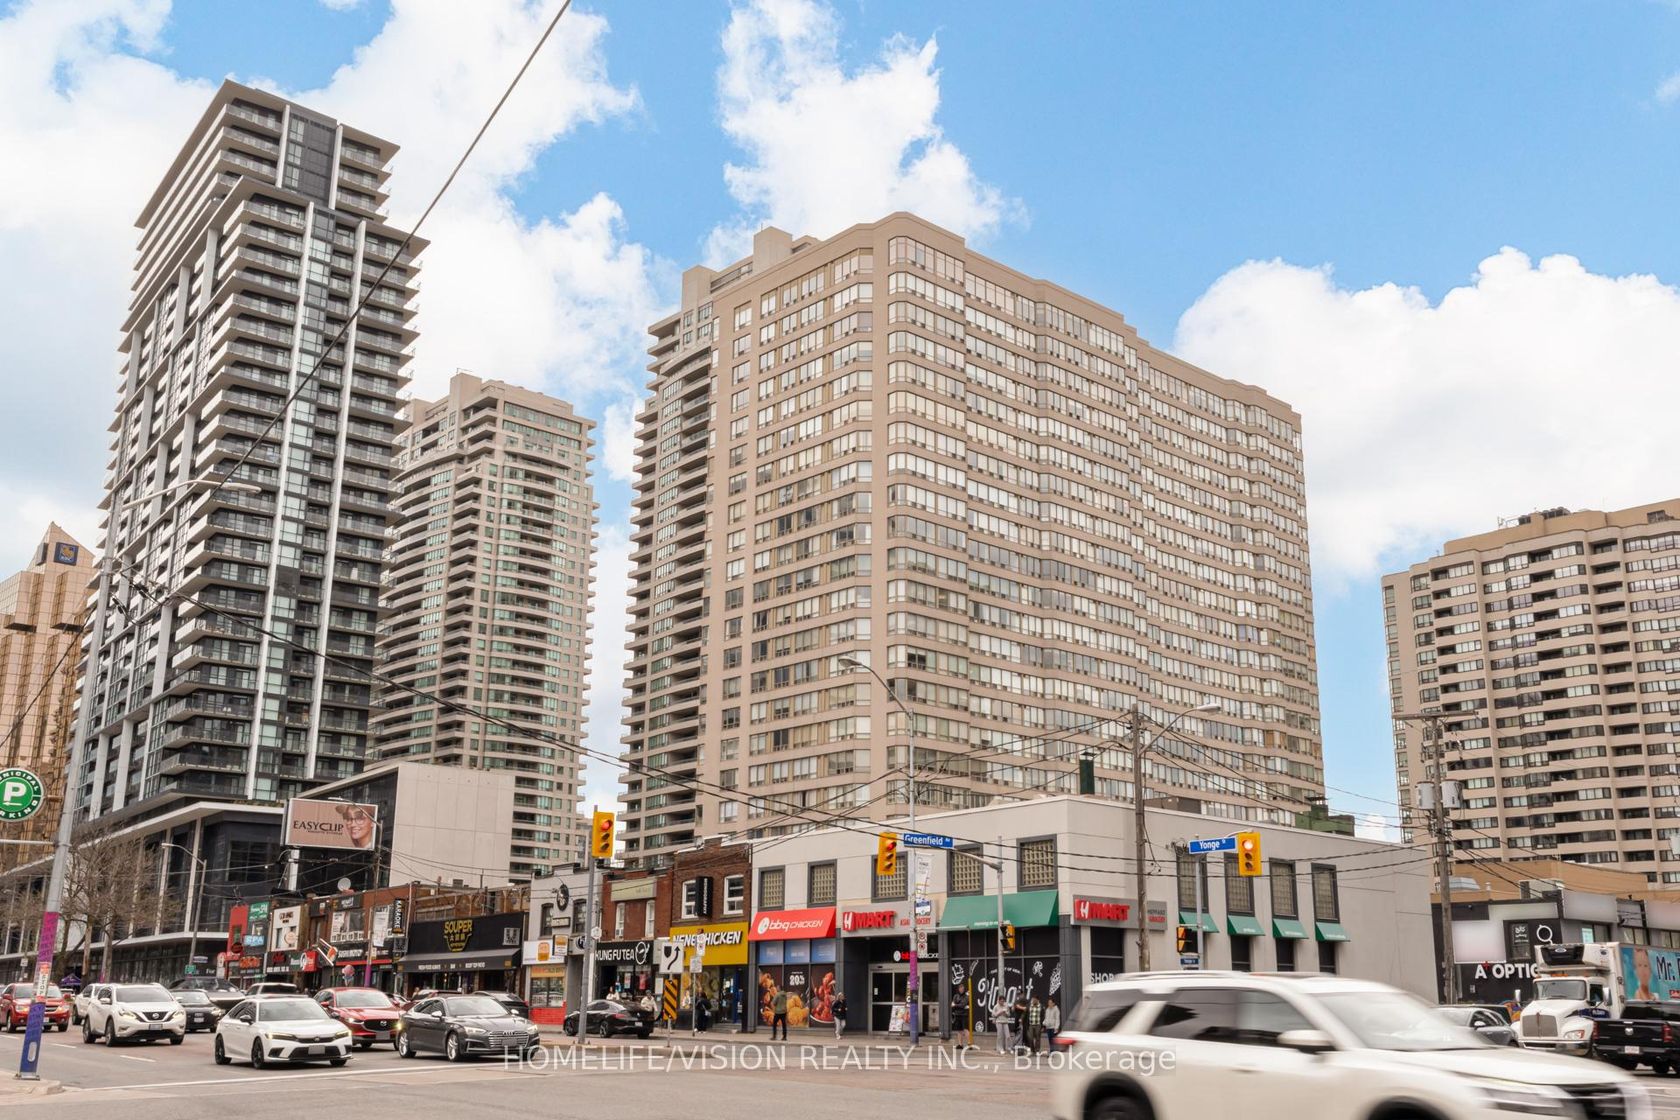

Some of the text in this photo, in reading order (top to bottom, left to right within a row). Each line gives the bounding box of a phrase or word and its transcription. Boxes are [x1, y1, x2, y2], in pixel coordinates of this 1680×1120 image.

[0, 771, 39, 791] NICIPAL
[3, 781, 27, 802] P
[0, 800, 38, 818] RKING
[905, 834, 944, 846] Greenfield
[1199, 839, 1220, 850] Yonge
[444, 919, 473, 933] SOUPER
[769, 919, 823, 931] bbq CHICKEN
[698, 931, 741, 946] HICKEN
[622, 949, 635, 960] TEA
